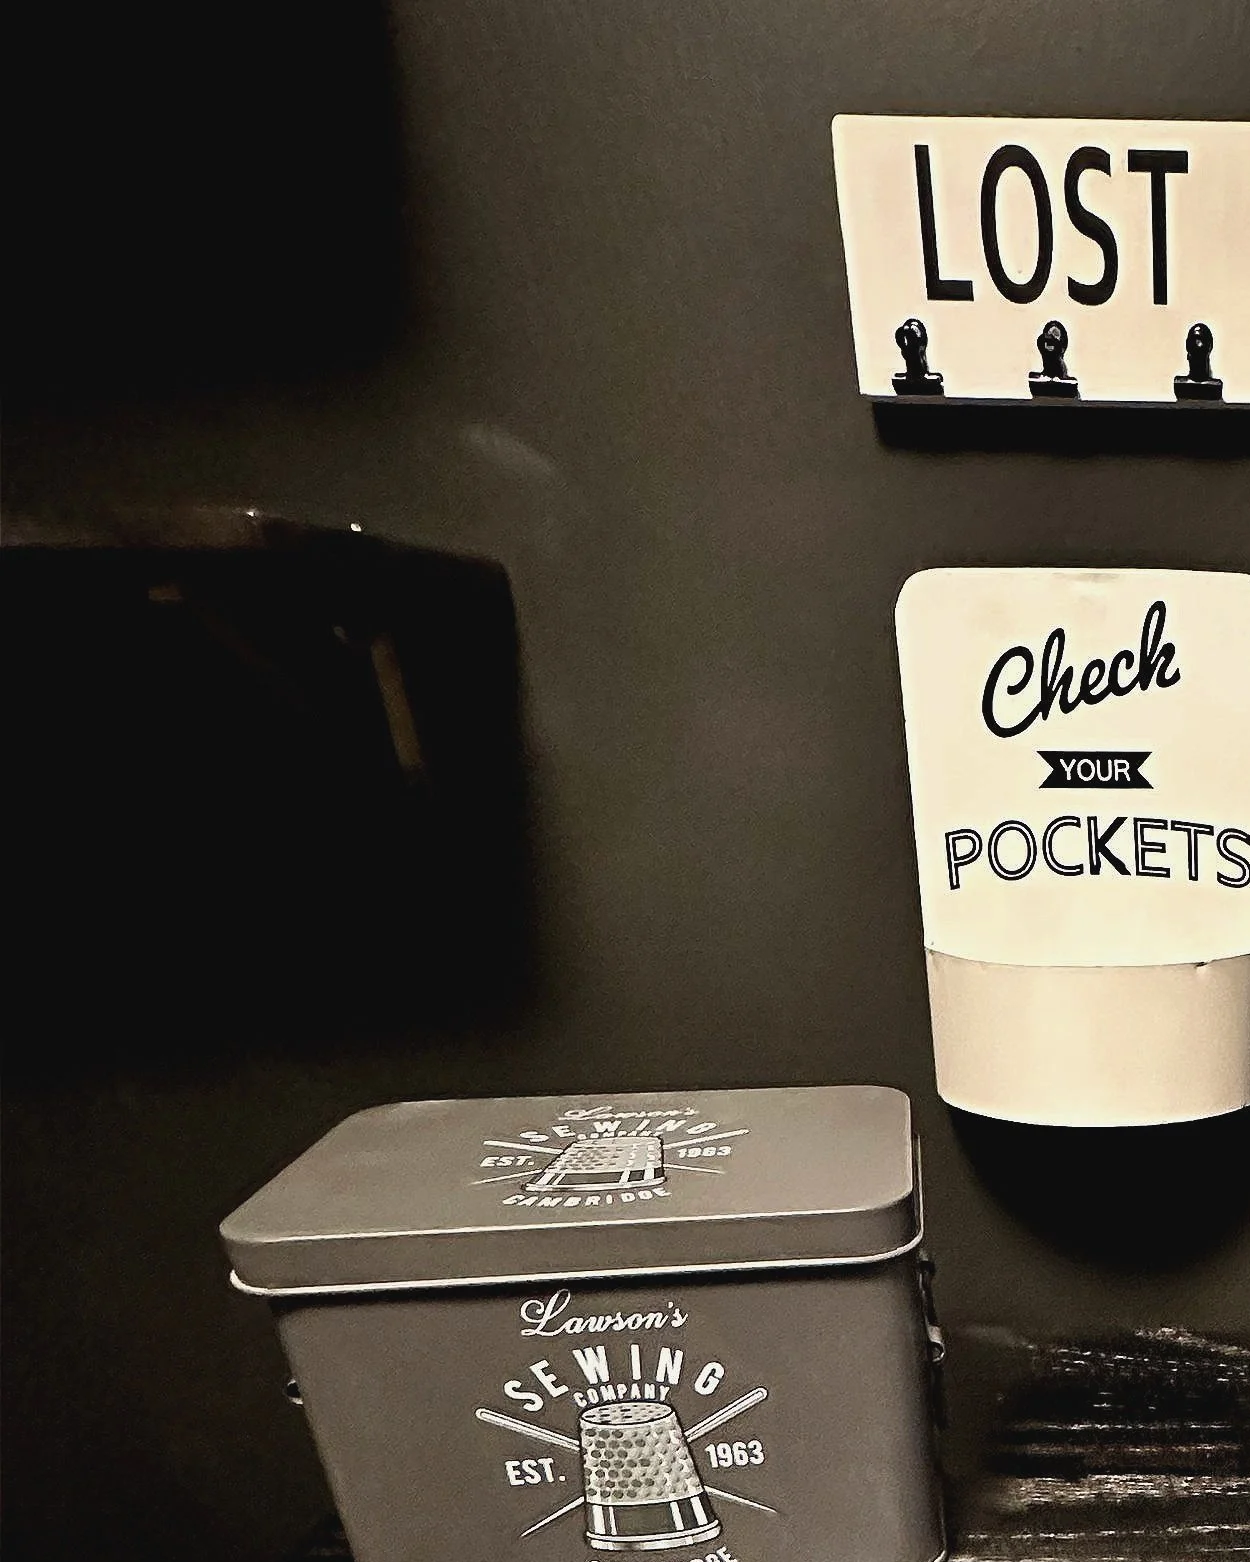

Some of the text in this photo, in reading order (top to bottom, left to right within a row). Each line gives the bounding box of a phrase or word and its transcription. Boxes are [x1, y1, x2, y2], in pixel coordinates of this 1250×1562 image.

[913, 145, 1189, 306] LOST
[982, 600, 1181, 738] Check
[1059, 758, 1132, 783] YOUR
[519, 1119, 718, 1143] SEWING
[480, 1146, 732, 1168] EST. 1963
[502, 1187, 672, 1208] CAMBRIDGE
[520, 1288, 689, 1337] Lawson's
[503, 1344, 725, 1412] SEWING
[573, 1383, 671, 1408] COMPANY
[504, 1439, 765, 1486] EST. 1963
